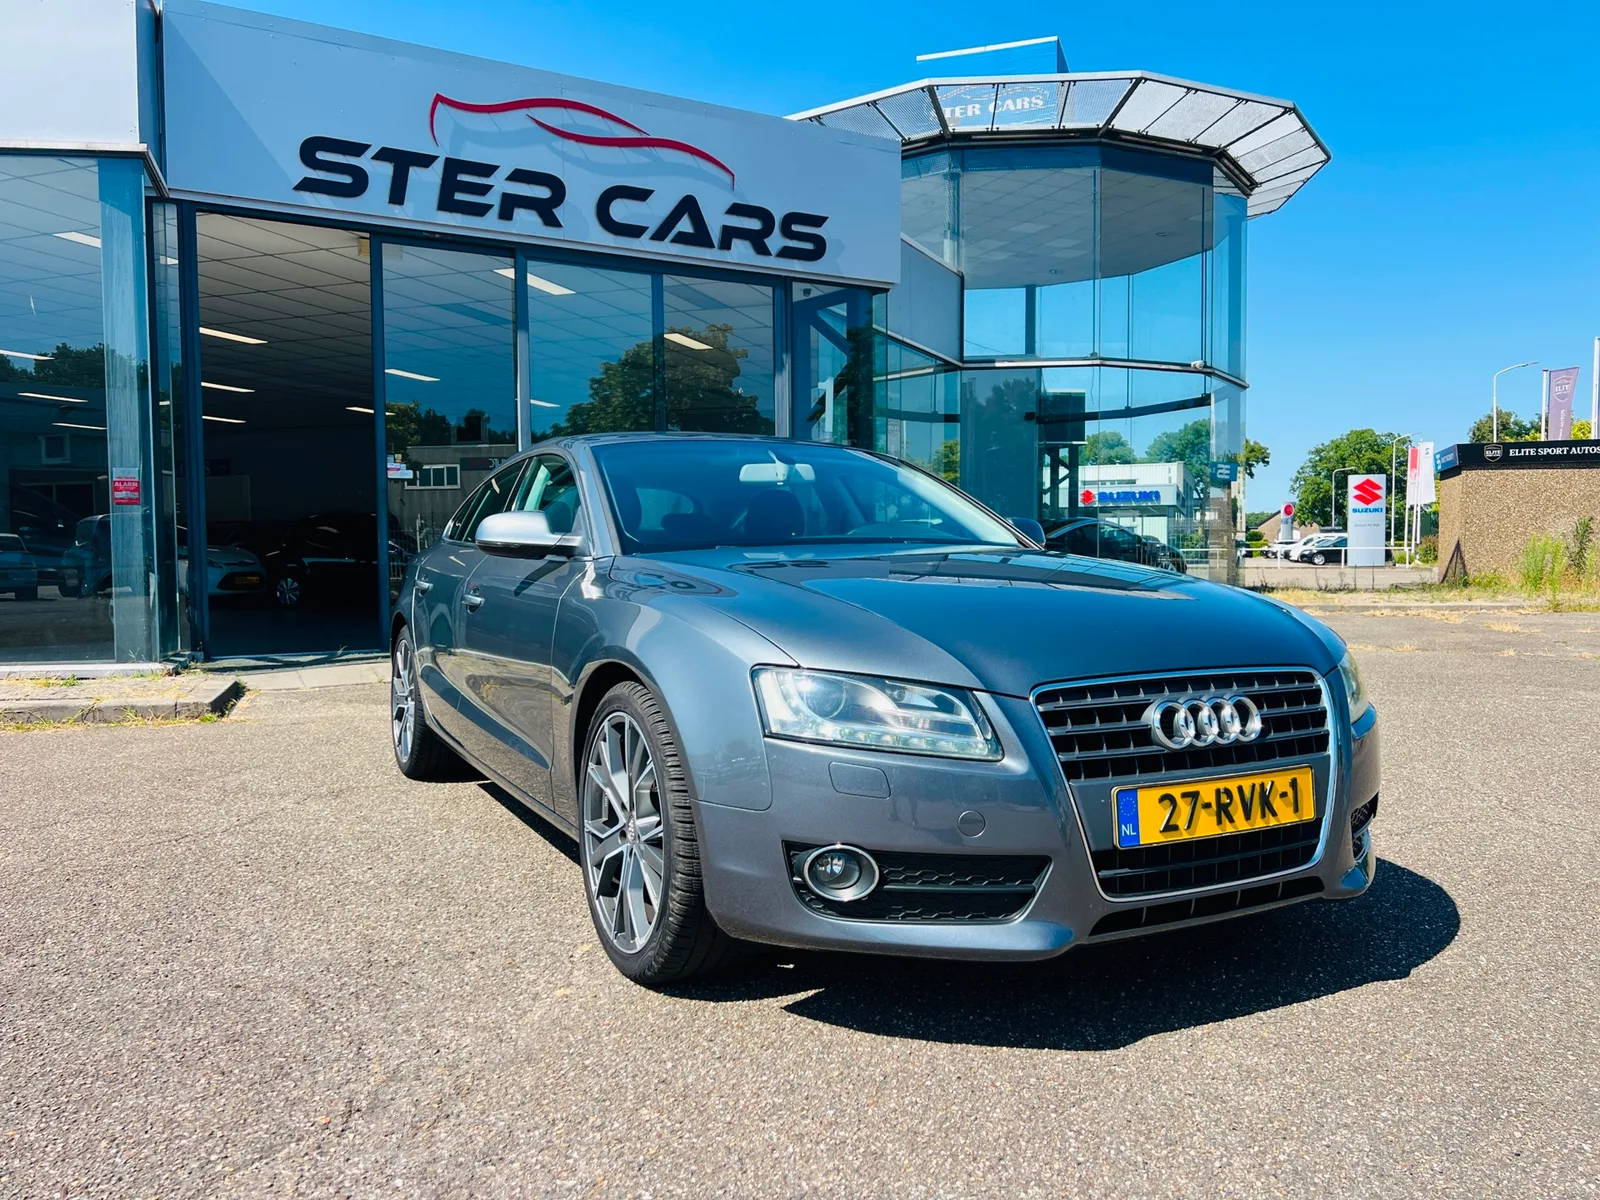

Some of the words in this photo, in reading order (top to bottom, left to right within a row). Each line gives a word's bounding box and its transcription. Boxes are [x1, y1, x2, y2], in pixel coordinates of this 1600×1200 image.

[989, 95, 1043, 112] CARS
[292, 136, 567, 228] STER
[596, 184, 829, 261] CARS
[1538, 447, 1569, 455] SPORT
[1570, 446, 1600, 454] AUTOS
[1098, 491, 1160, 502] SUZUKI
[1158, 777, 1299, 833] 27-RVK-1
[1121, 824, 1137, 837] NL
